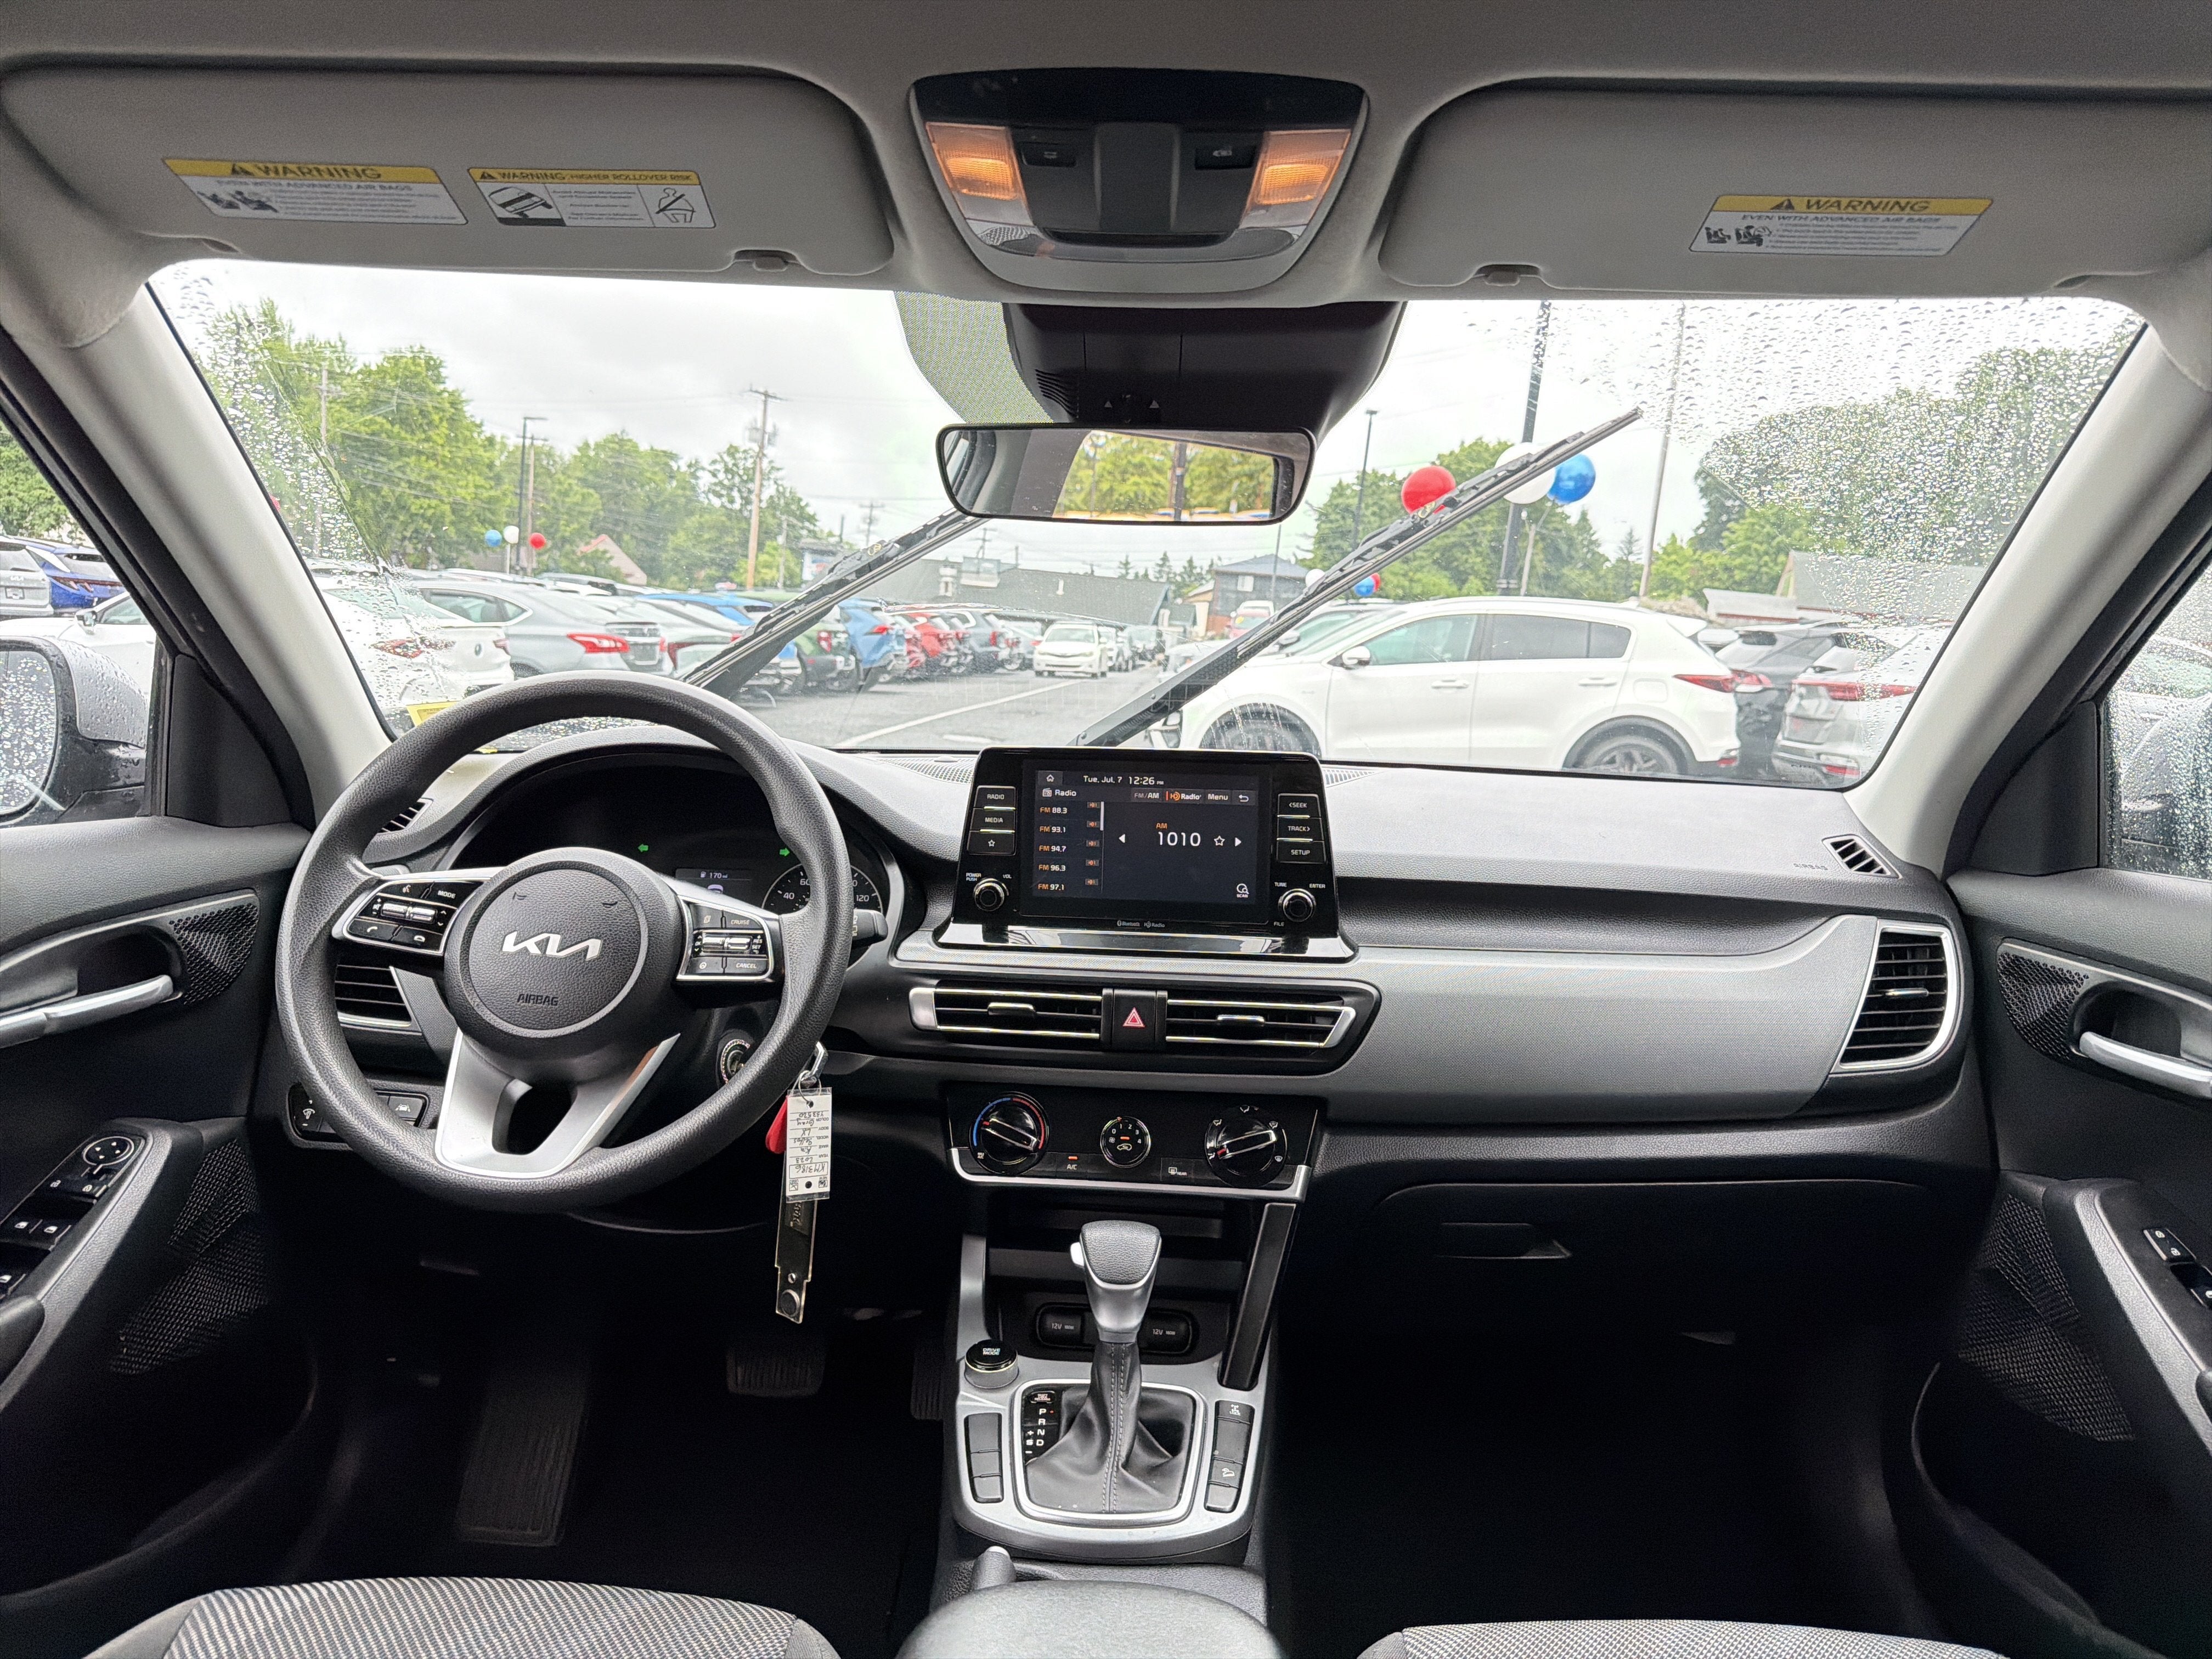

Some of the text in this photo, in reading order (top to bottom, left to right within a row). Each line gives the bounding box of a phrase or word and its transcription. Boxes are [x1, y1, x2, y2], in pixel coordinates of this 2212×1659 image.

[252, 163, 381, 179] WARNING
[1806, 199, 1931, 212] WARNING
[1128, 776, 1155, 785] 12:26
[1054, 789, 1077, 797] Radio
[1158, 831, 1201, 847] 1010
[437, 890, 456, 899] MODE
[501, 930, 602, 961] KIA
[517, 994, 559, 1006] AIRBAG
[795, 1163, 826, 1173] KM3186
